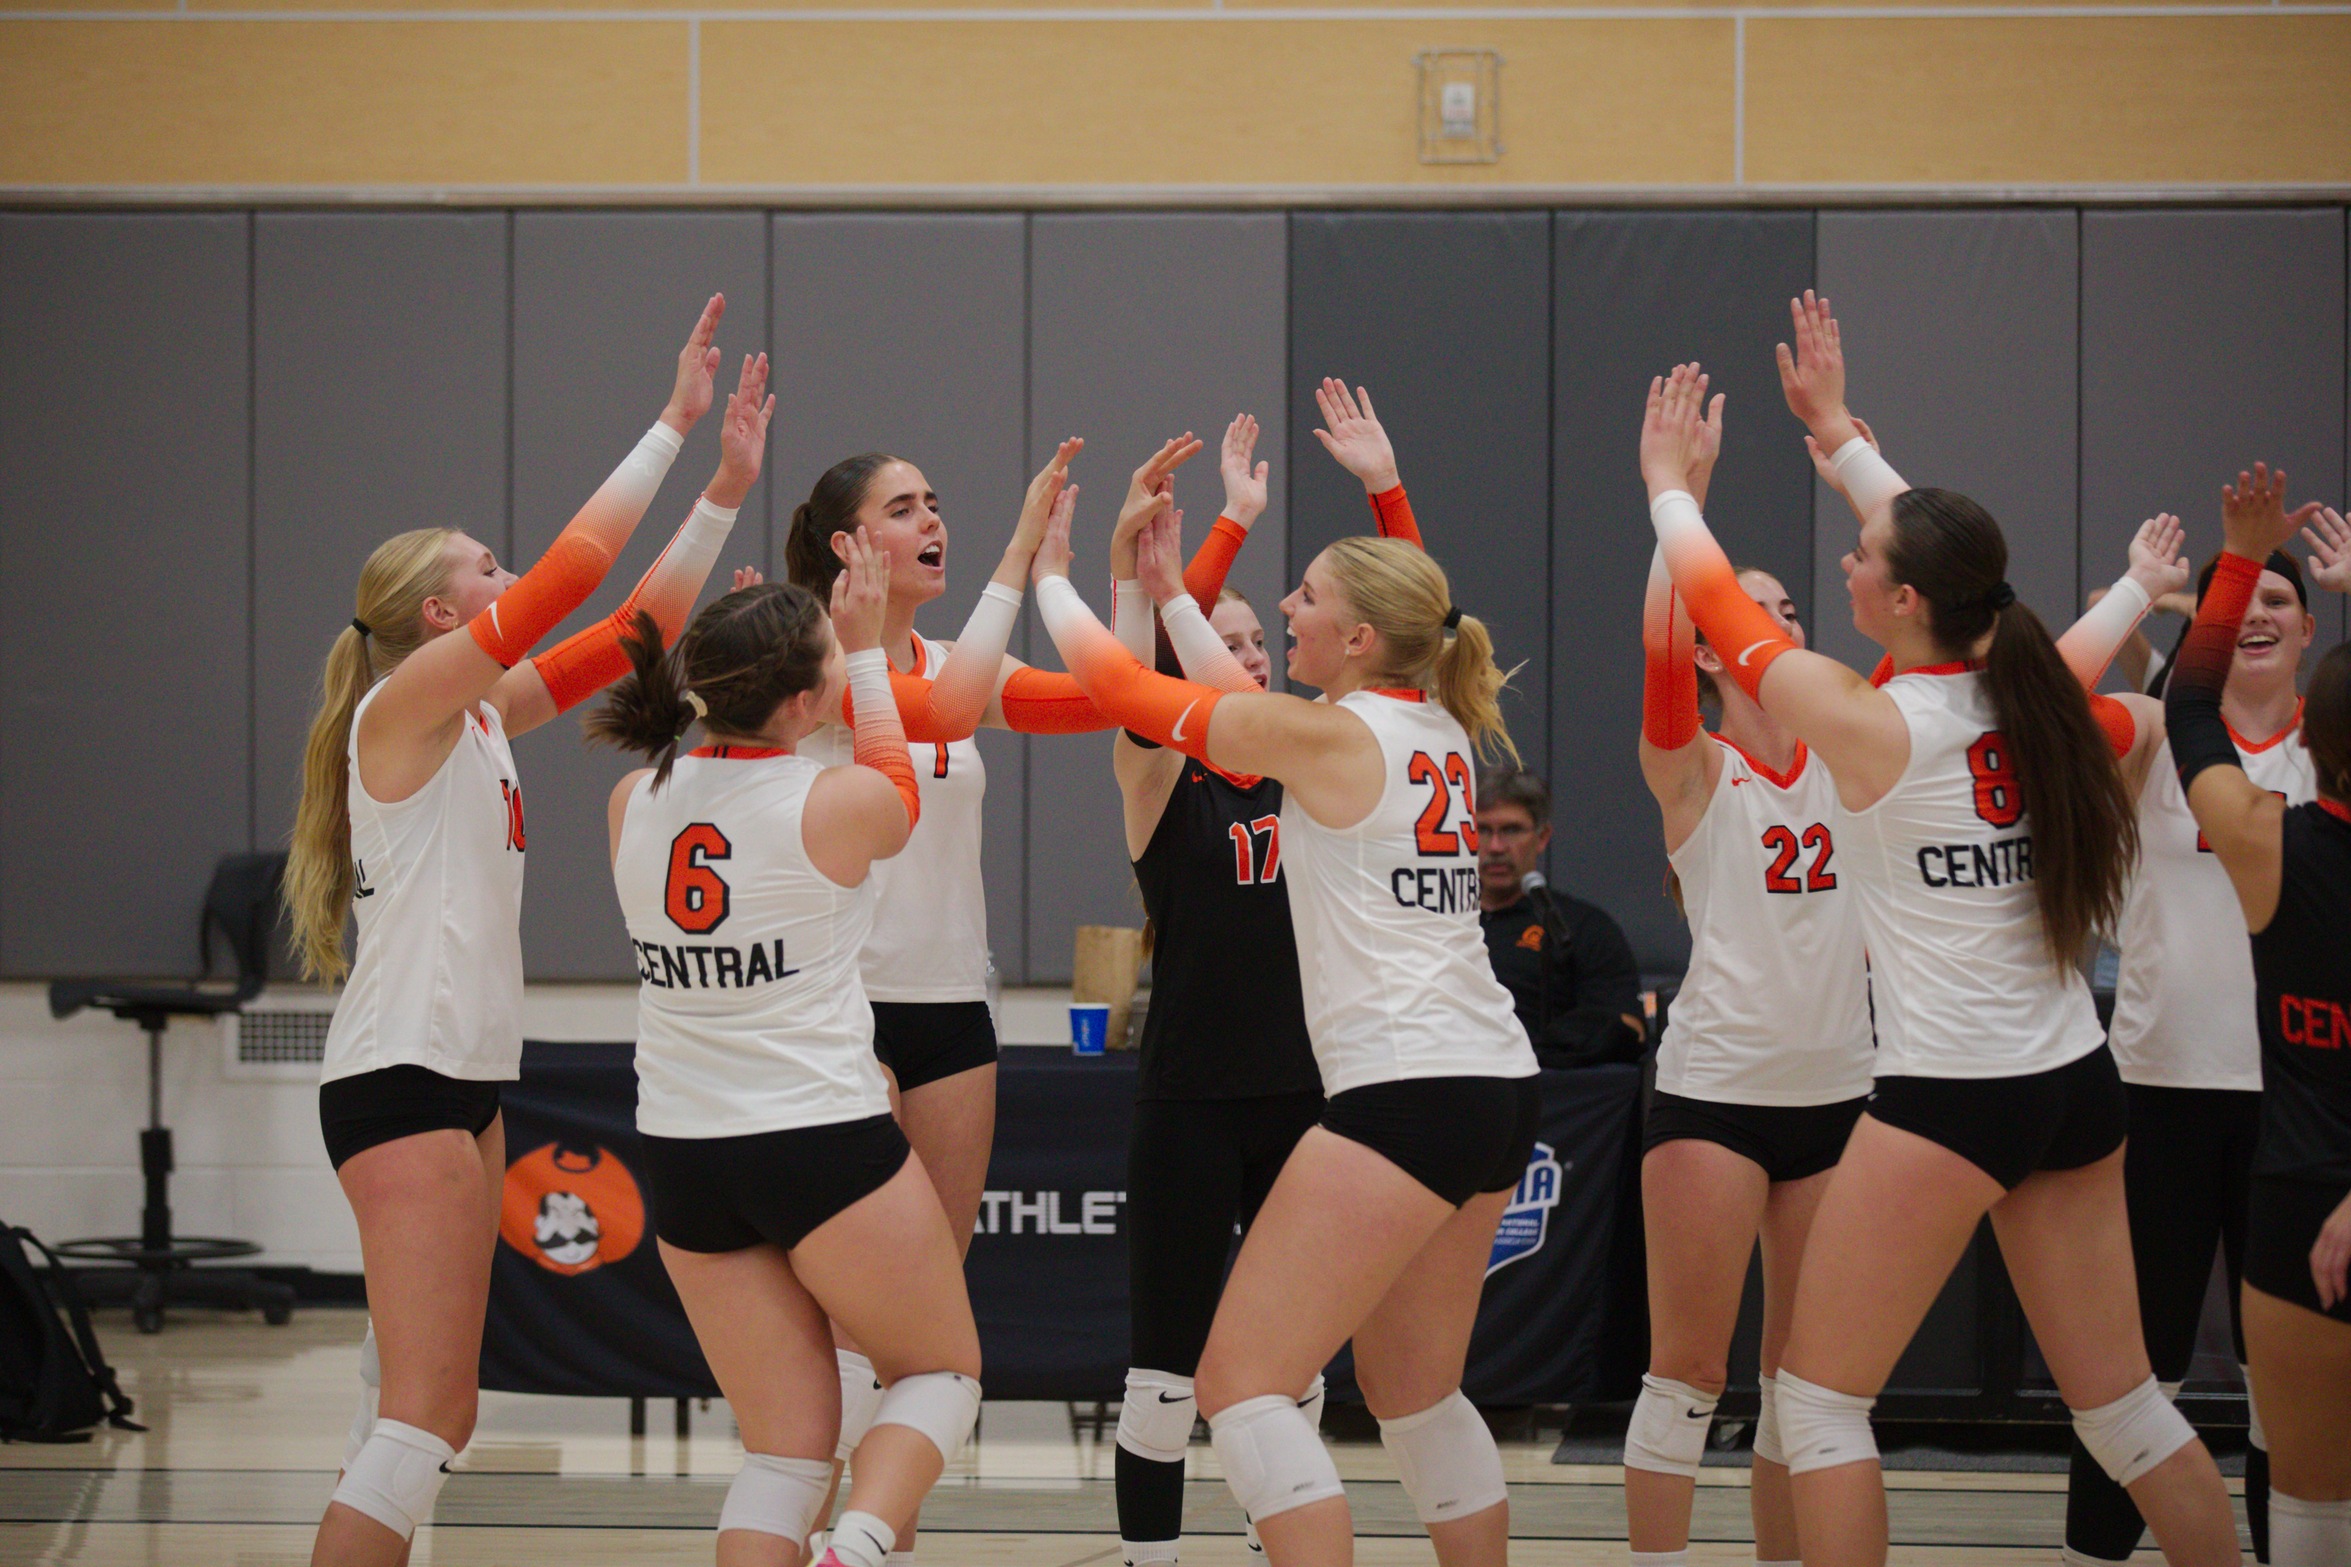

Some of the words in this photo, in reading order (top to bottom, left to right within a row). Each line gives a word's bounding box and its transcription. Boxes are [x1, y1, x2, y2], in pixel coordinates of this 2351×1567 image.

[1408, 750, 1479, 857] 23
[1966, 730, 2025, 829] 8
[664, 822, 731, 935] 6
[1229, 813, 1280, 885] 17
[1761, 822, 1837, 893] 22
[1917, 836, 2034, 888] CENTR
[1391, 867, 1482, 914] CENTR
[632, 938, 800, 988] CENTRAL
[2280, 994, 2351, 1049] CEN
[974, 1190, 1127, 1235] THLE
